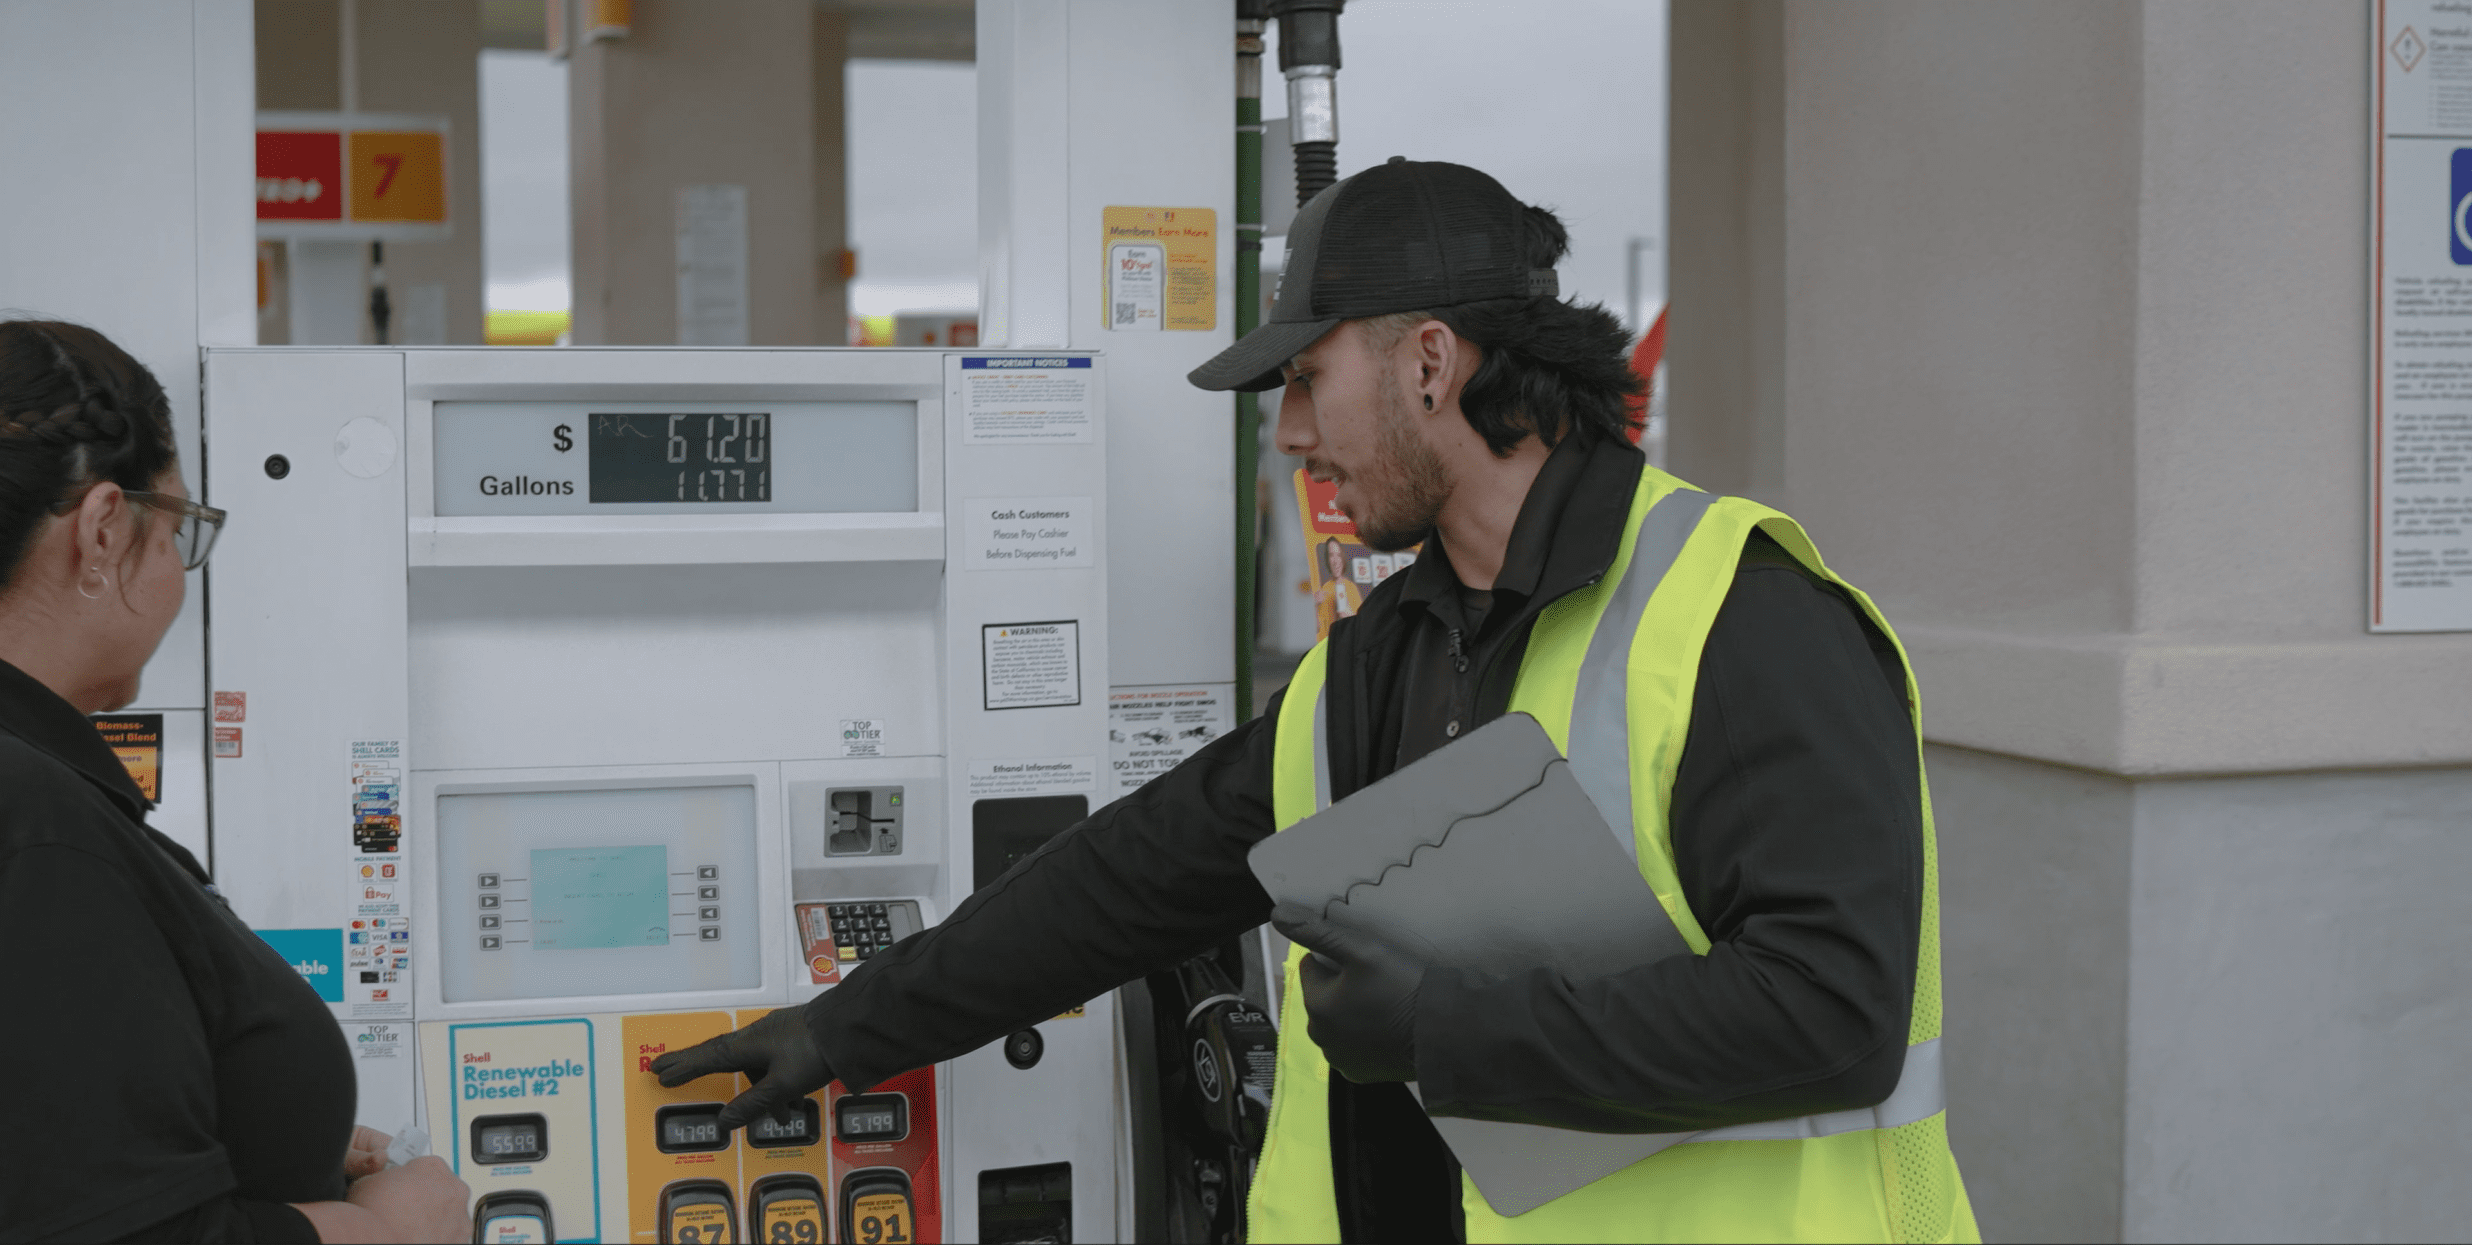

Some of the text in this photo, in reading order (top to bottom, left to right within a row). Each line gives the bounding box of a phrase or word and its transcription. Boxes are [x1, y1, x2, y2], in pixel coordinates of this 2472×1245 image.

[372, 153, 405, 201] 7
[1158, 227, 1180, 236] Earn
[1183, 227, 1209, 237] More
[987, 358, 1069, 368] IMPORTANT NOTICES
[553, 424, 574, 453] $
[480, 475, 574, 496] Gallons
[991, 510, 1070, 520] Cash Customers
[993, 528, 1069, 541] Please Pay Cashier
[986, 547, 1076, 560] Before Dispensing Fuel
[1010, 626, 1059, 636] WARNING:
[853, 721, 872, 730] TOP
[127, 733, 156, 742] Blend
[860, 730, 881, 739] TIER
[993, 762, 1073, 773] Ethanol Information
[1113, 761, 1130, 770] DO
[1132, 759, 1154, 769] NOT
[375, 891, 392, 900] Pay
[293, 959, 329, 975] able
[1229, 1012, 1265, 1022] EVR
[367, 1025, 389, 1035] TOP
[376, 1033, 399, 1042] TIER
[639, 1043, 666, 1054] Shell
[463, 1052, 491, 1063] Shell
[463, 1058, 584, 1082] Renewable
[464, 1078, 559, 1100] Diesel #2
[678, 1223, 724, 1244] 87
[771, 1219, 818, 1244] 89
[861, 1214, 907, 1244] 91
